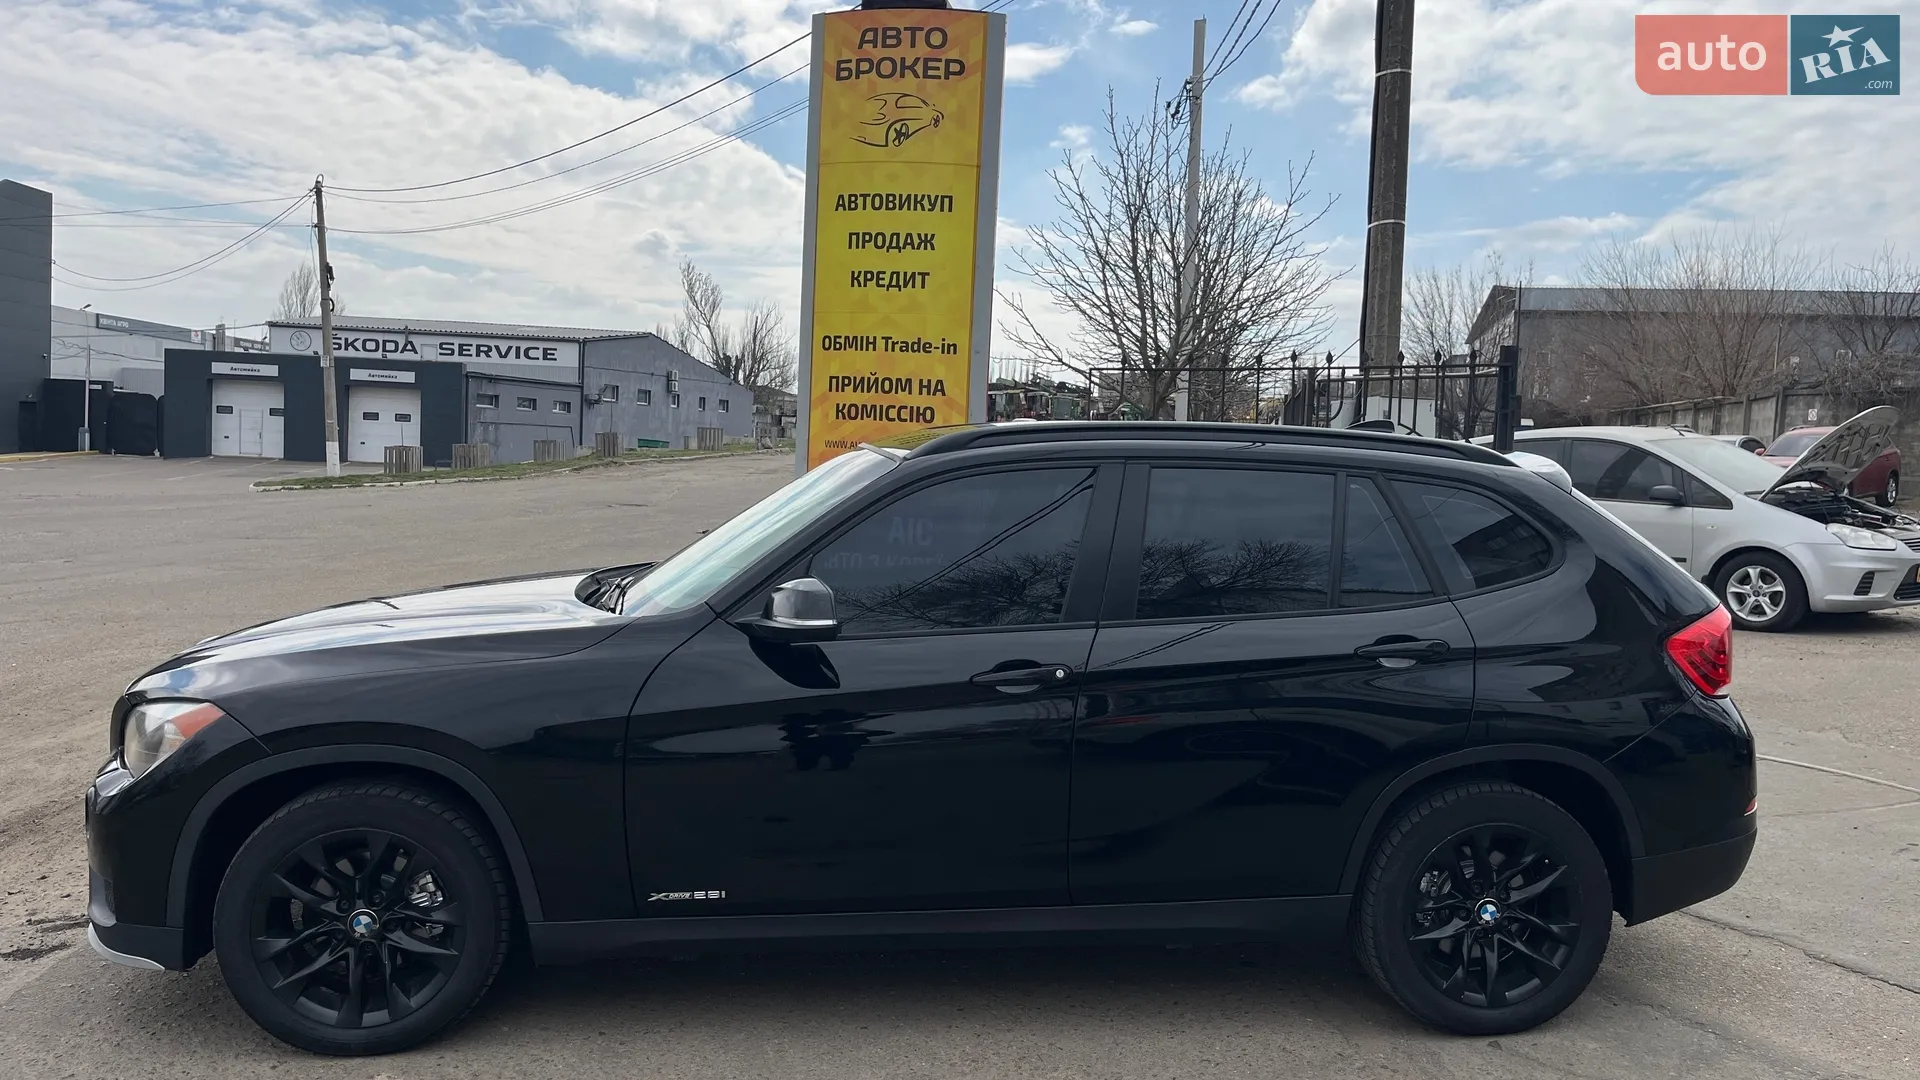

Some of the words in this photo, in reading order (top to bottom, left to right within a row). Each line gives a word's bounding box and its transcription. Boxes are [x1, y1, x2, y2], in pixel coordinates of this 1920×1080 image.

[857, 26, 948, 50] АВТО
[835, 56, 966, 82] БРОКЕР
[834, 193, 953, 213] АВТОВИКУП
[848, 231, 936, 253] ПРОДАЖ
[850, 270, 930, 292] КРЕДИТ
[332, 333, 419, 355] ŠKODA
[438, 341, 558, 361] SERVICE
[821, 335, 877, 351] ОБМІН
[881, 336, 958, 355] Trade-in
[828, 372, 913, 395] ПРИЙОМ
[918, 379, 947, 397] НА
[835, 403, 936, 423] КОМІССІЮ
